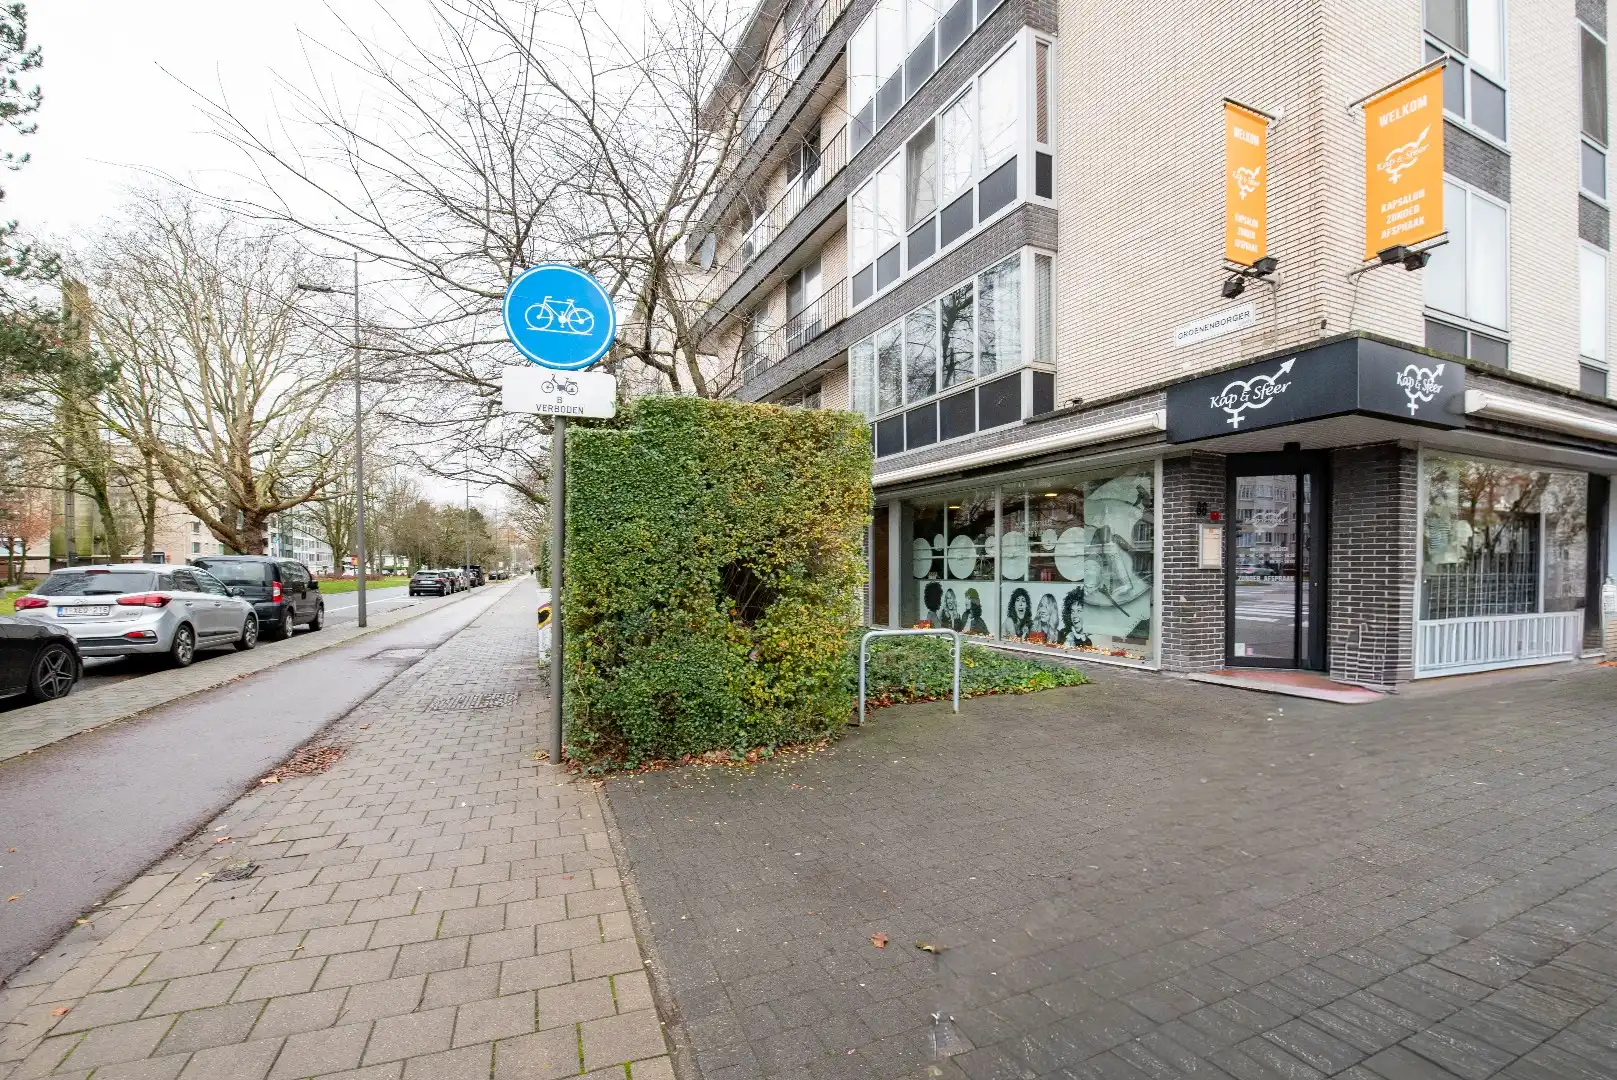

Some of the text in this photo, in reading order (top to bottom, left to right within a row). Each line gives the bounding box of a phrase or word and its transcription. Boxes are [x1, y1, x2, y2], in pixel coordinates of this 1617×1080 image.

[1380, 94, 1427, 128] WELKOM
[1233, 126, 1260, 146] WELKOM
[1381, 188, 1425, 214] KAPSALON
[1386, 203, 1420, 225] ZONDER
[1381, 215, 1425, 240] AFSPRAAK
[1178, 310, 1250, 340] GROENENBORGER
[1210, 381, 1292, 409] Kap & Sfeer
[1396, 372, 1443, 395] Kap & Sfeer
[536, 403, 584, 415] VERBODEN
